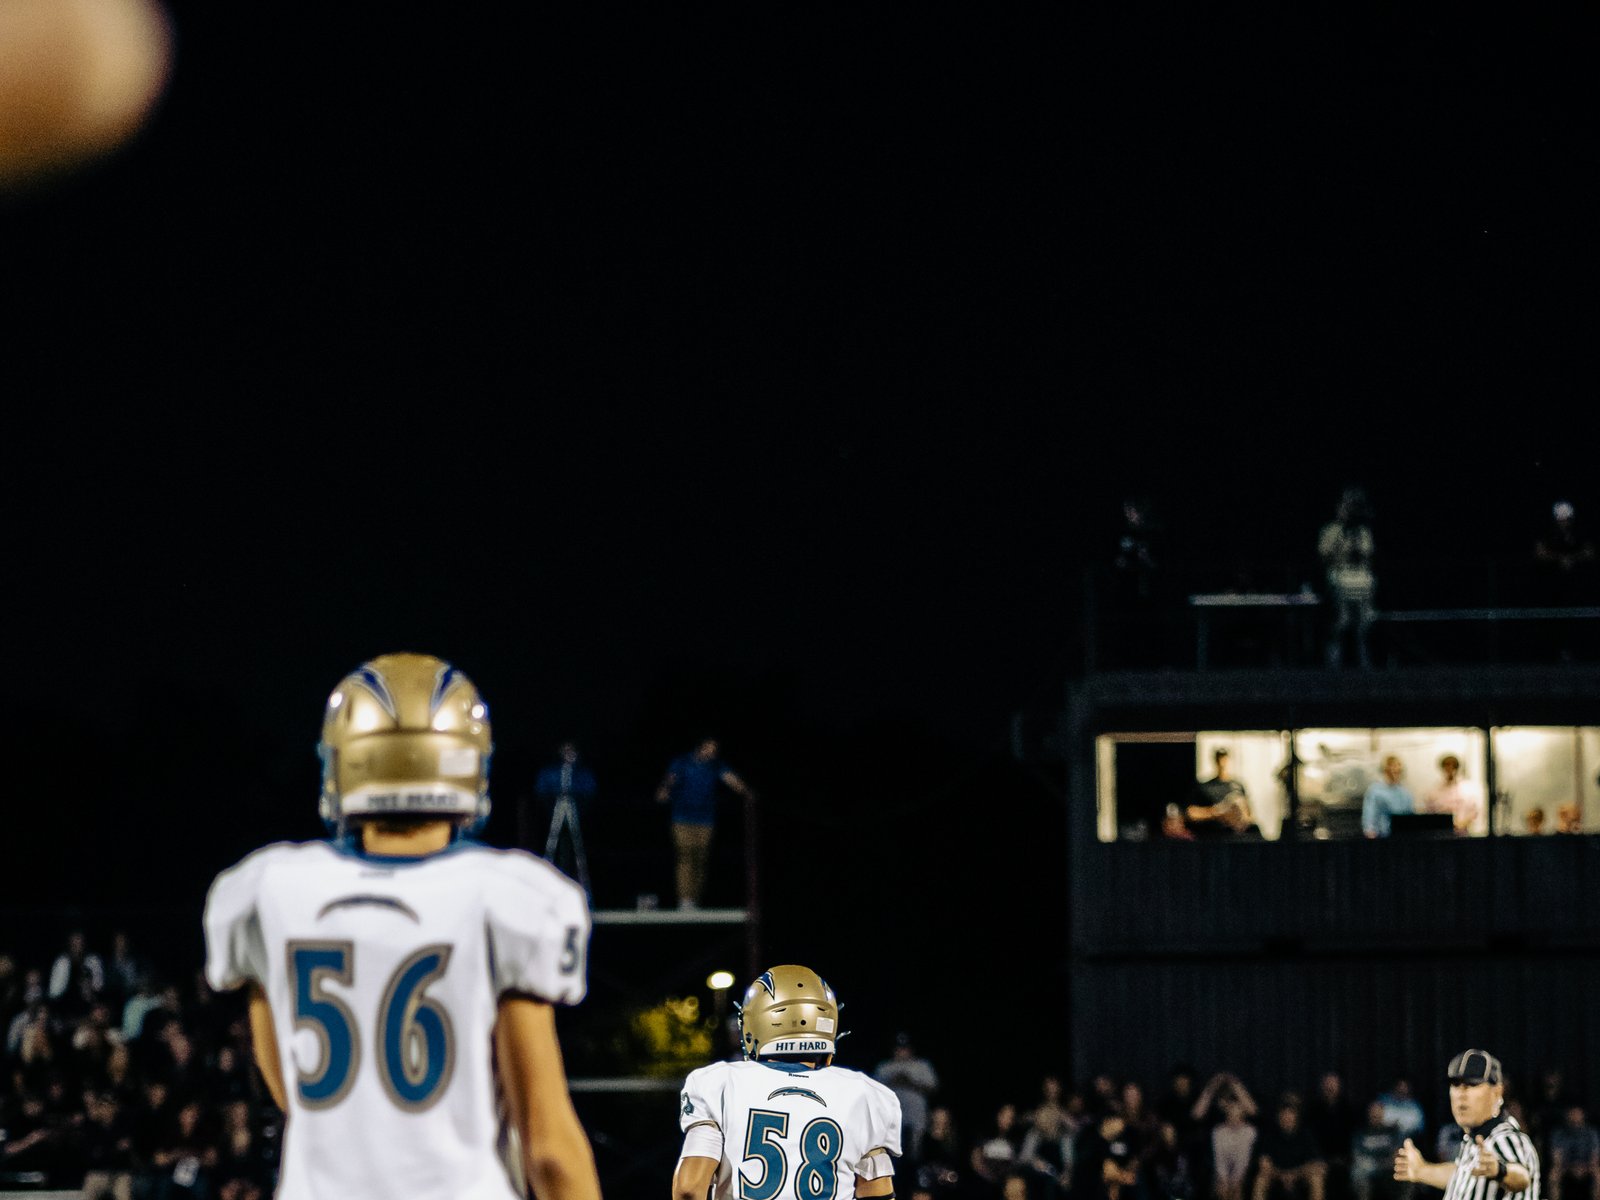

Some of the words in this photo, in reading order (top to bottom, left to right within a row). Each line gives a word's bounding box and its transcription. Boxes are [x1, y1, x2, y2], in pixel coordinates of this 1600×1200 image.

[286, 939, 455, 1114] 56
[775, 1042, 796, 1051] HIT
[799, 1041, 827, 1051] HARD
